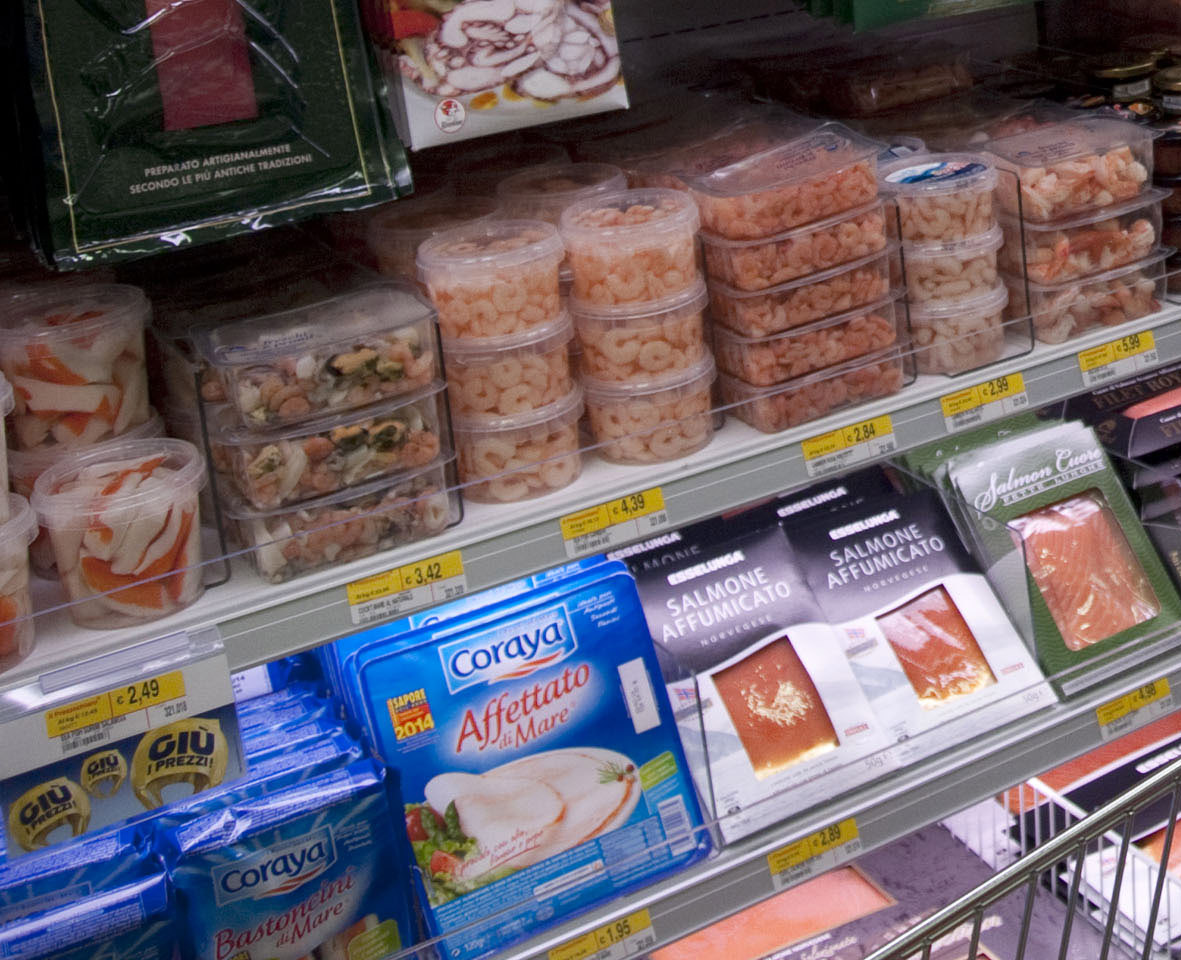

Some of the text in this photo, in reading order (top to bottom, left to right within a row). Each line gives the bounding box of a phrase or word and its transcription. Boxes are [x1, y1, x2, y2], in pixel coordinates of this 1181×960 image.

[129, 153, 313, 195] SECONDO LE ANTICHE TRADIZIONI
[144, 143, 291, 177] PREPARATO ARTIGIANALMENTE
[1122, 334, 1141, 353] 5,99
[988, 376, 1009, 397] 2,99
[1093, 383, 1146, 411] FILET
[854, 422, 876, 443] 2,84
[621, 494, 646, 515] 4,39
[777, 487, 848, 518] ESSELUNGA
[975, 466, 1054, 516] Salmon
[1001, 481, 1046, 506] FETTE
[828, 509, 900, 541] ESSELUNGA
[607, 531, 682, 561] ESSELUNGA
[829, 523, 923, 567] SALMONE
[414, 562, 442, 587] 3,42
[667, 550, 745, 586] ESSELUNGA
[826, 534, 945, 590] AFFUMICATO
[666, 566, 770, 617] SALMONE
[863, 565, 930, 592] NORVEGESE
[662, 580, 792, 644] AFFUMICATO
[700, 614, 773, 647] NORVEGESE
[450, 619, 567, 678] Coraya
[128, 678, 159, 705] 2,49
[392, 687, 427, 709] SAPORE
[456, 662, 591, 754] Affettato
[395, 713, 435, 741] 2014
[499, 704, 569, 752] di Mare
[149, 725, 215, 762] GIÙ
[87, 753, 119, 776] GIÙ
[155, 757, 214, 771] PREZZI!
[19, 784, 73, 827] GIÙ
[31, 801, 77, 831] PREZZI!
[819, 823, 842, 846] 2,89
[220, 839, 325, 893] Coraya
[290, 901, 344, 945] Mare
[607, 920, 632, 943] 1,95
